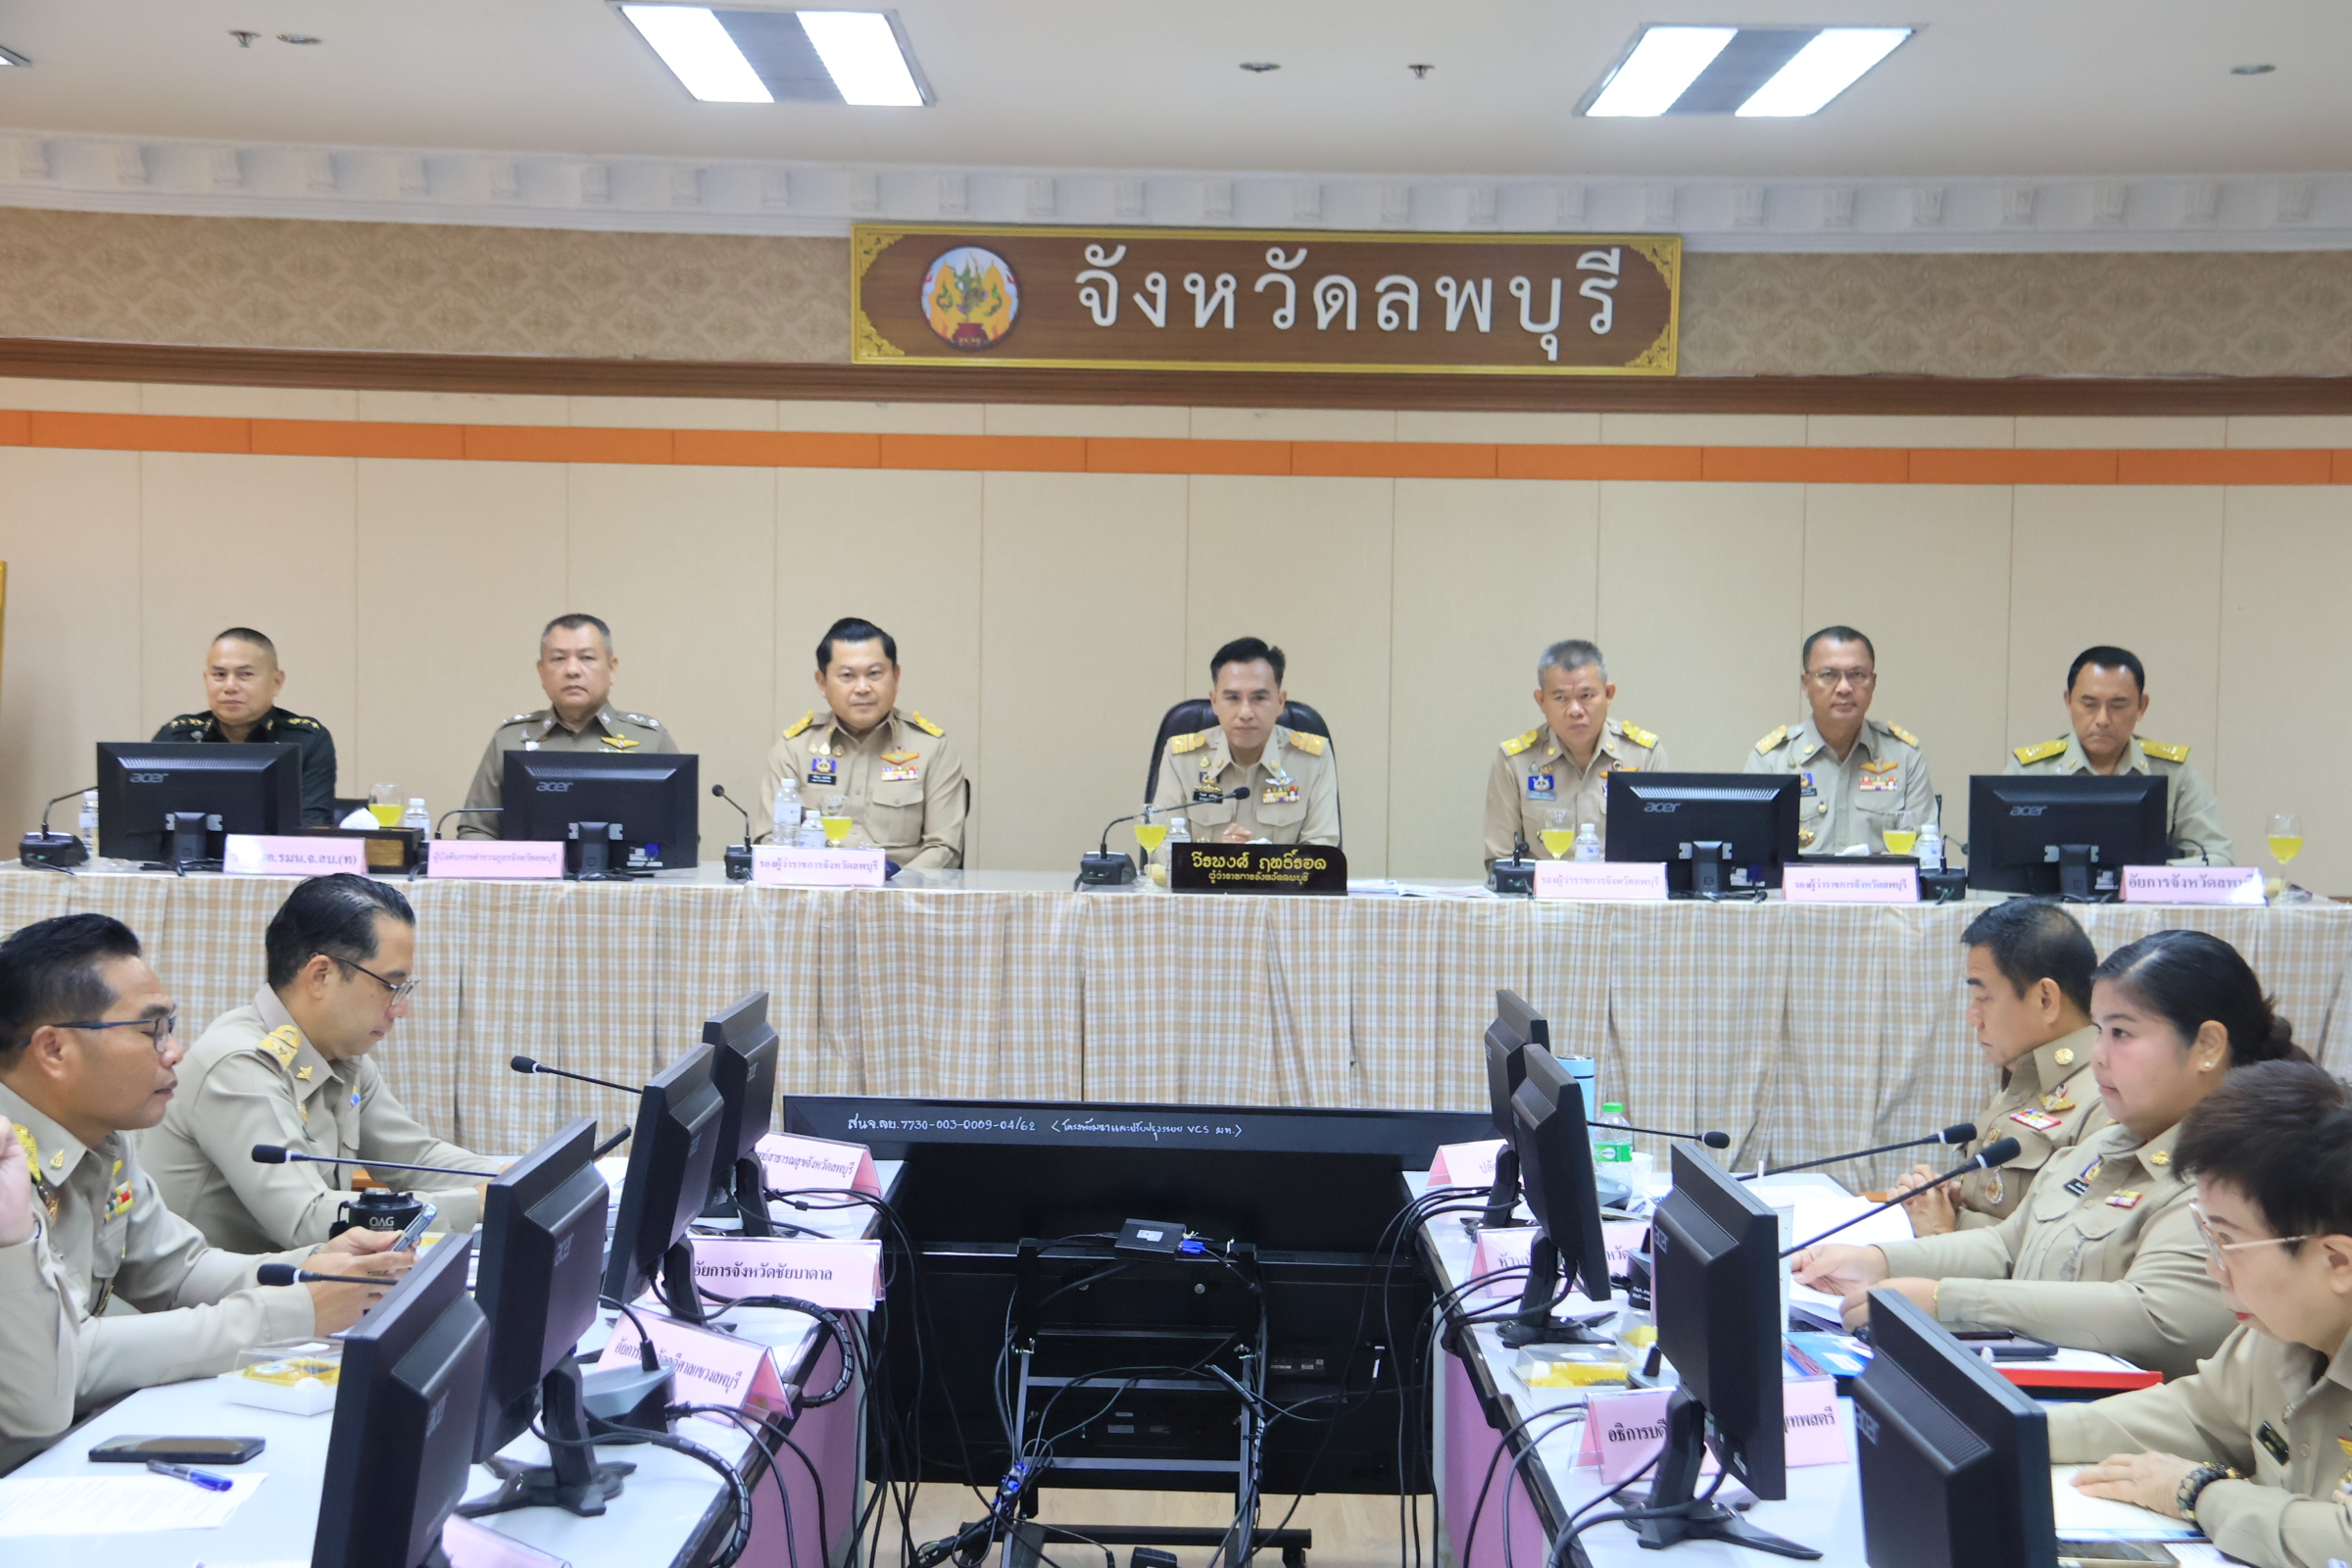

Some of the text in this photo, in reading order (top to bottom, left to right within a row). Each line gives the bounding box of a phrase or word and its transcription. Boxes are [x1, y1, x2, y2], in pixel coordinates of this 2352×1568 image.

[1075, 244, 1622, 362] จังหวัดลพบุรี
[129, 772, 169, 783] acer
[536, 781, 573, 792] acer
[1643, 802, 1682, 812] acer
[2009, 806, 2047, 816] acer
[1187, 1125, 1209, 1134] VCS
[694, 1260, 833, 1281] อัยการจังหวัดชัยบาดาล
